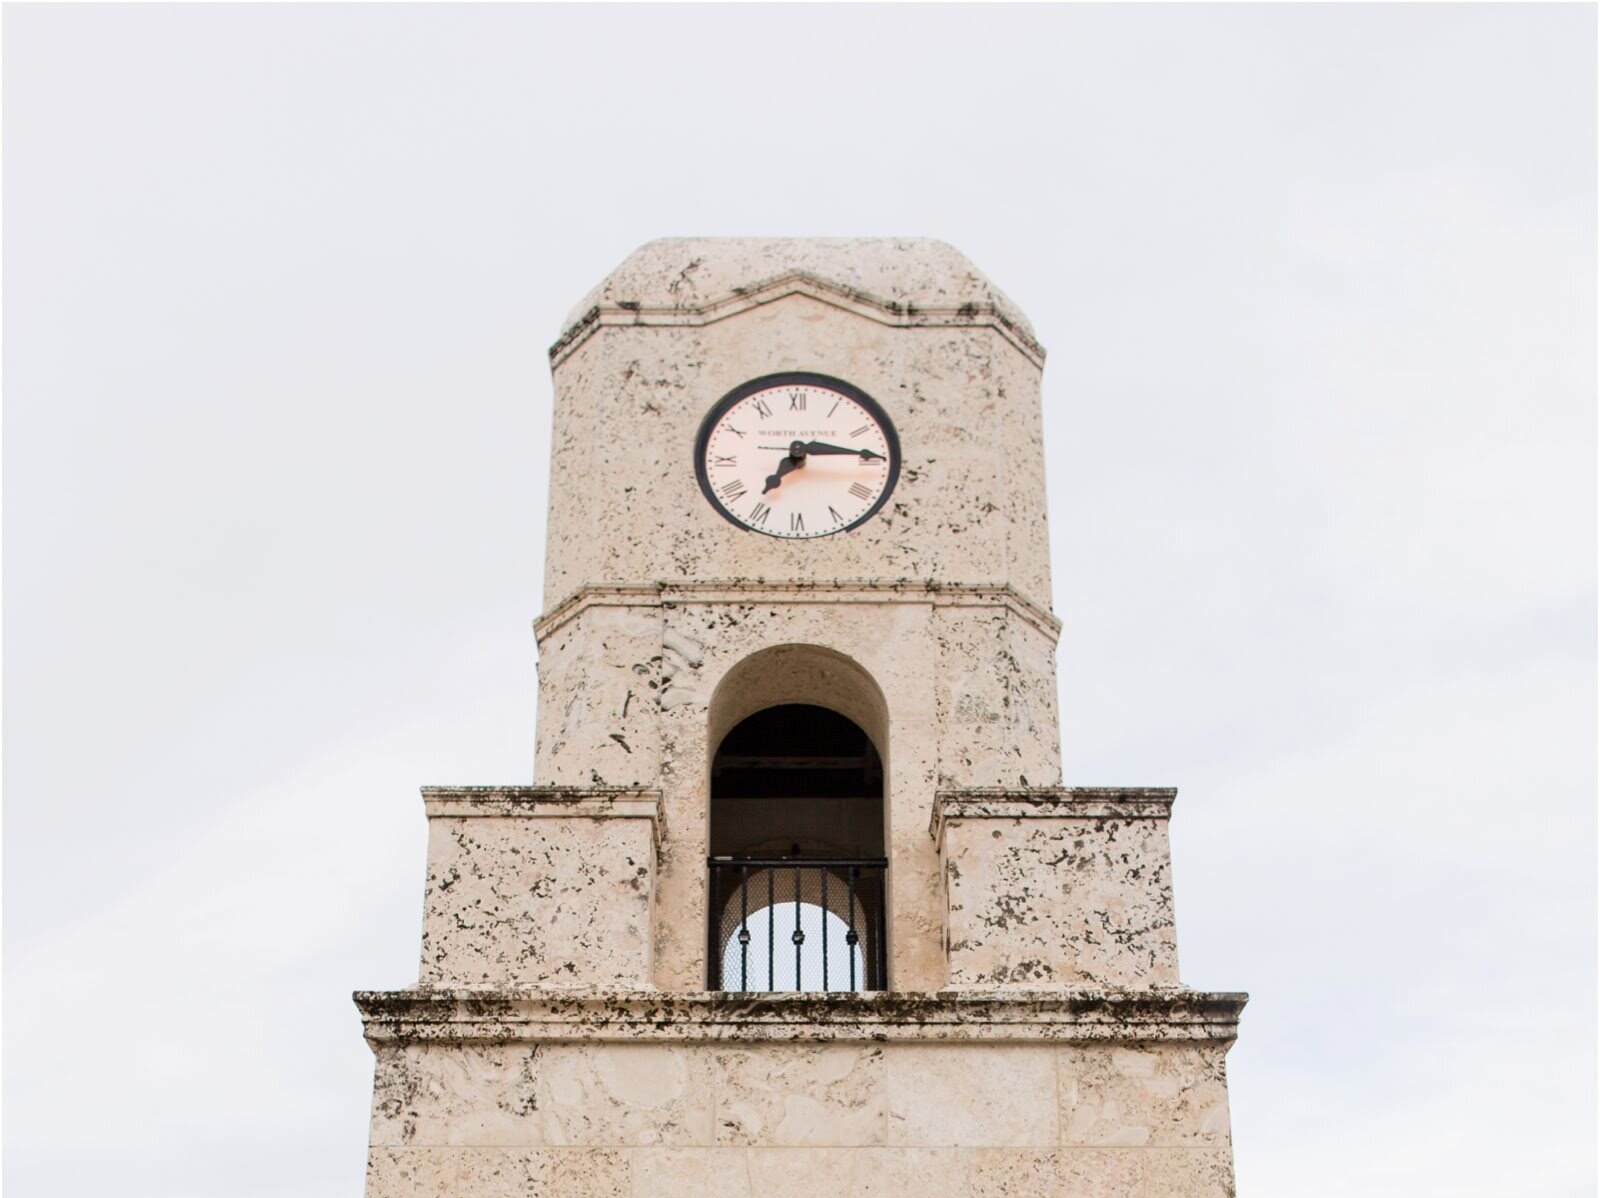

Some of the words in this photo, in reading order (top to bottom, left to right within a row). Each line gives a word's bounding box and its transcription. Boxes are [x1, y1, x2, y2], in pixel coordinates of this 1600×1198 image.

[752, 399, 773, 420] XI
[789, 393, 806, 411] XII
[725, 424, 747, 439] X
[715, 456, 737, 467] IX
[721, 479, 748, 503] VIII
[749, 502, 771, 525] VII
